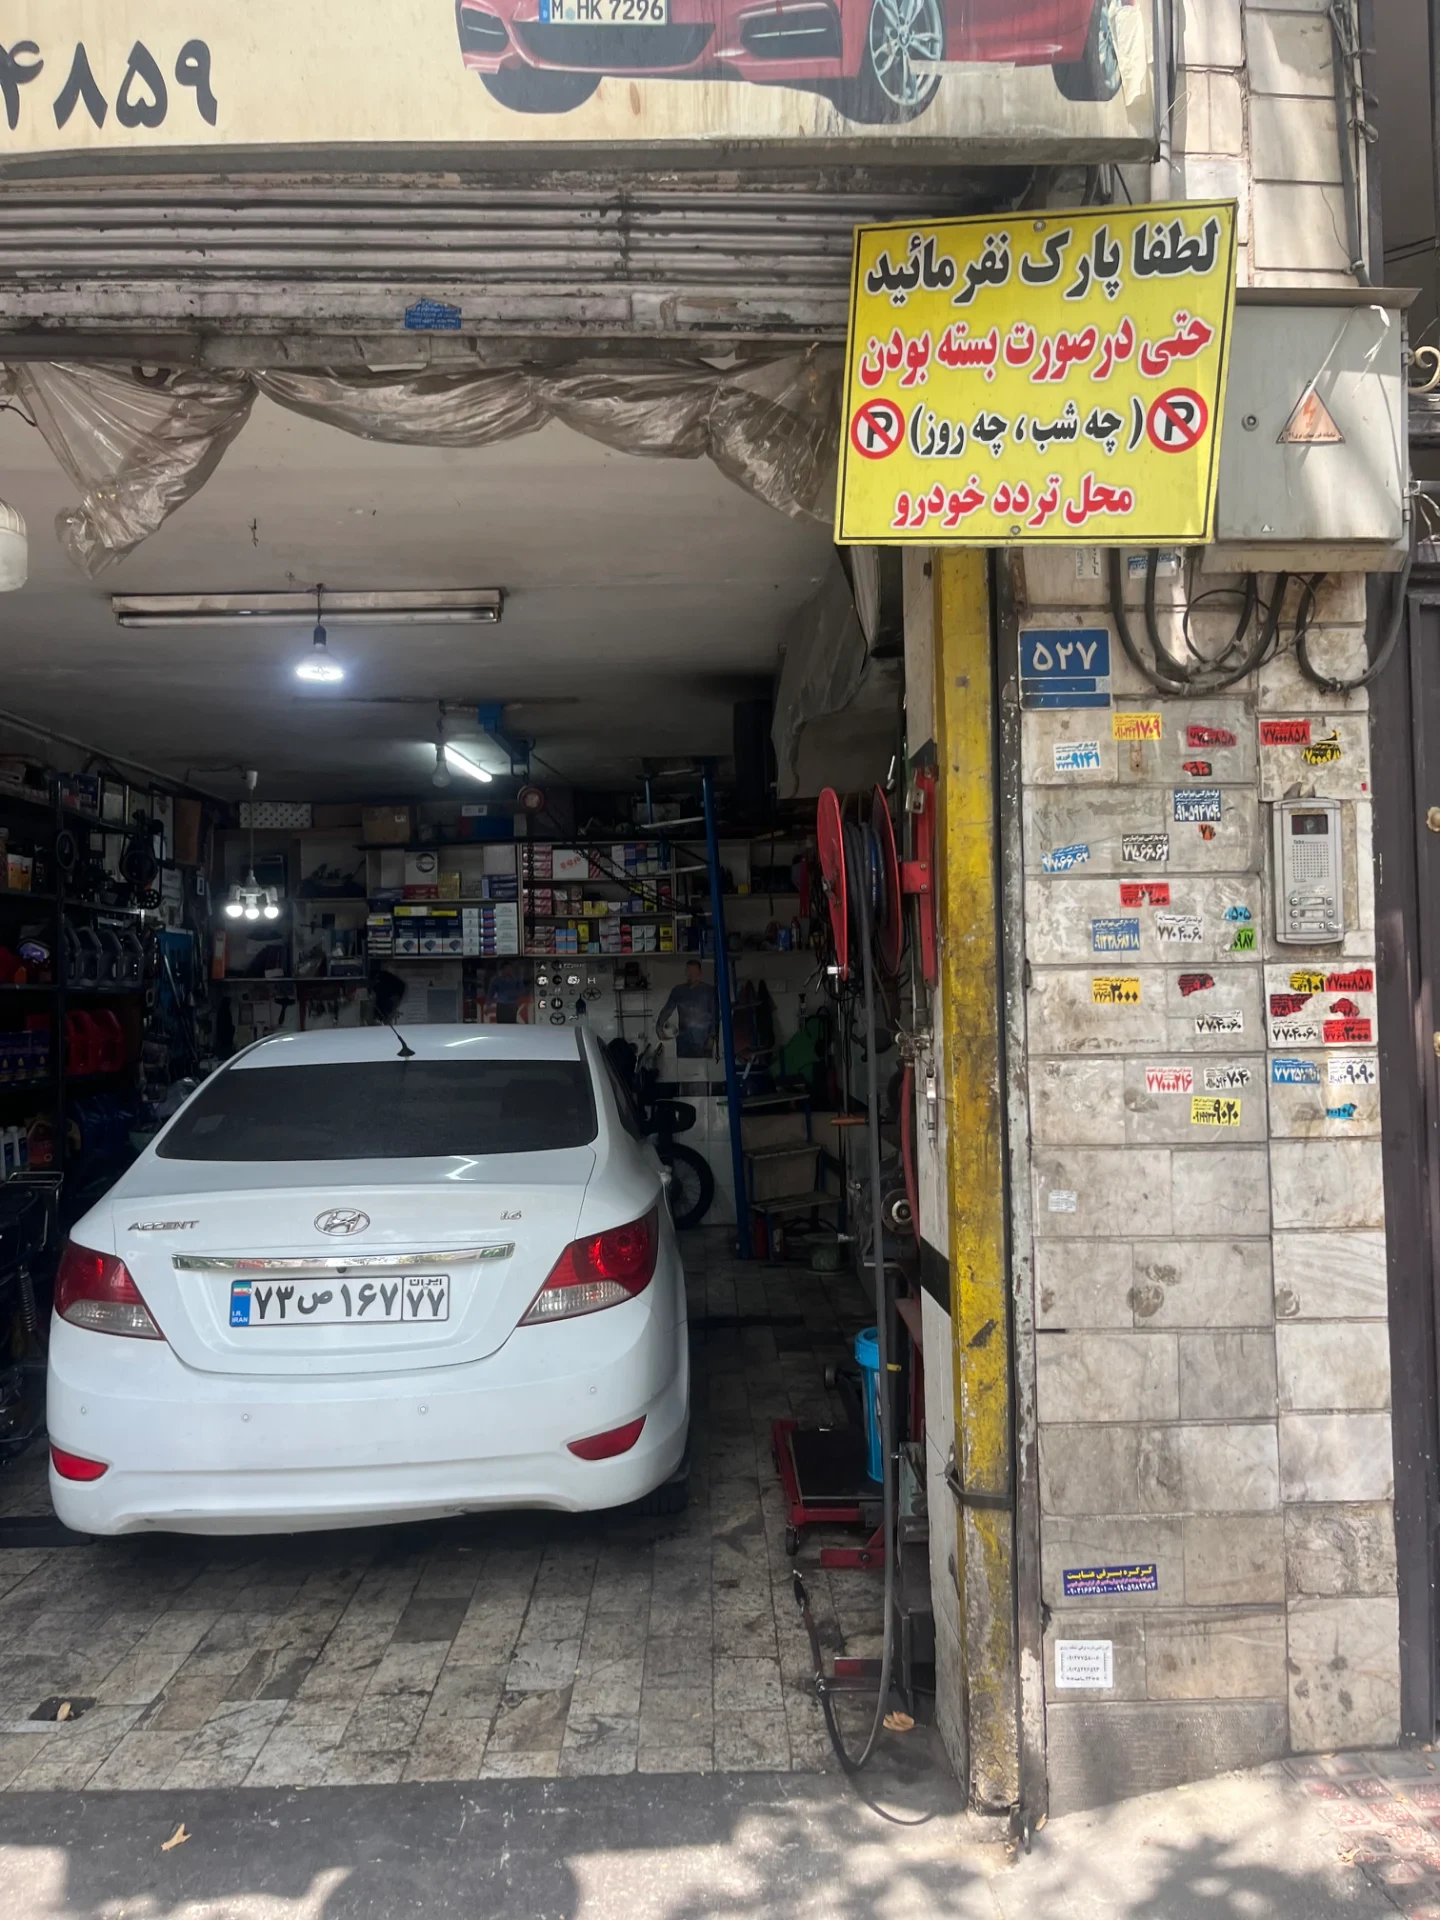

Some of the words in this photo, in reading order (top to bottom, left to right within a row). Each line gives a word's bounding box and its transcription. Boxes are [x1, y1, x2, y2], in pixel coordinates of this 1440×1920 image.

[1020, 226, 1121, 298] پارک
[1132, 217, 1219, 276] لطفا
[860, 328, 932, 386] بودن
[937, 321, 998, 380] بسته
[1140, 312, 1213, 375] حتی
[972, 411, 1008, 455] چه
[893, 475, 986, 527] خودرو
[993, 476, 1060, 526] تردد
[1065, 474, 1134, 524] محل
[1032, 641, 1097, 671] ۵۲۷
[1158, 925, 1203, 942] ۷۷۰۴۰۰۶۰
[1196, 1018, 1242, 1033] ۷۷۰۴۰۰۶۰
[1272, 1027, 1317, 1041] ۷۷۰۴۰۰۶۰
[406, 1288, 445, 1318] ۷۷
[409, 1278, 443, 1287] ایران
